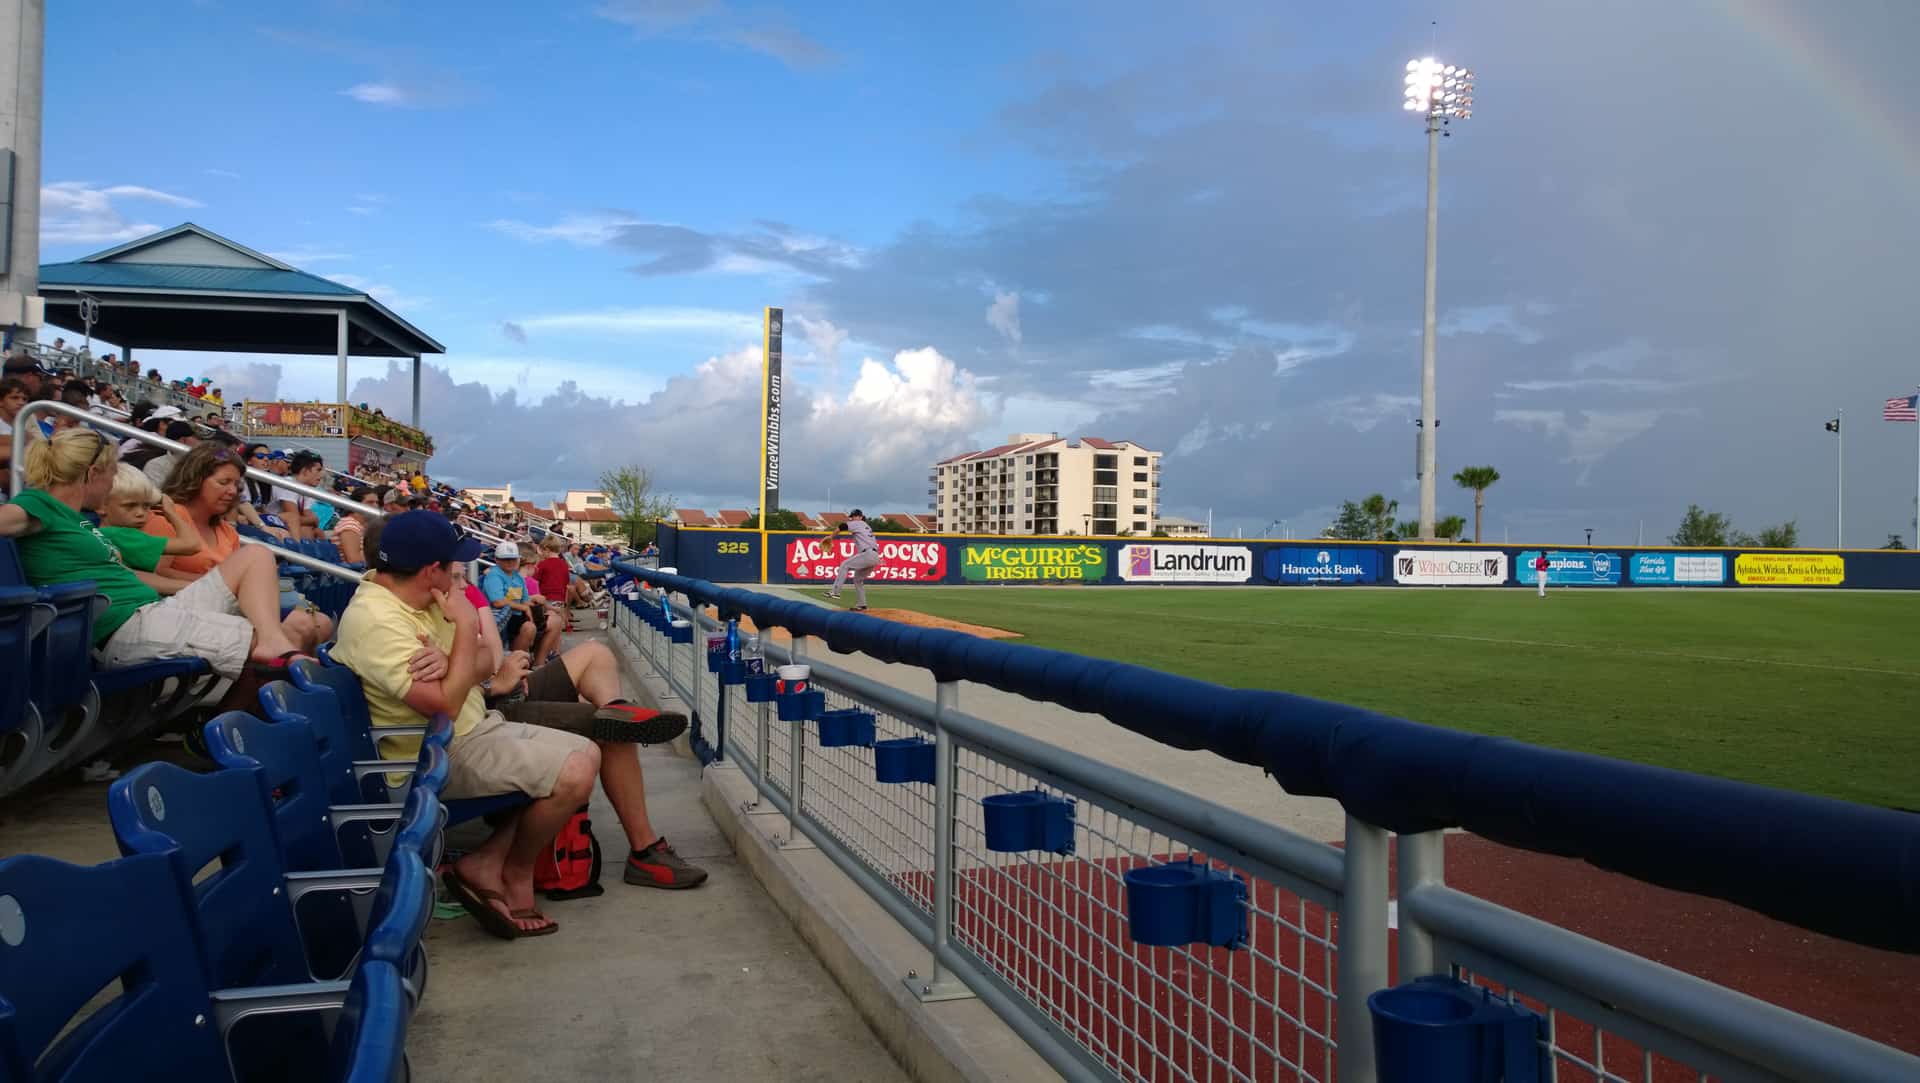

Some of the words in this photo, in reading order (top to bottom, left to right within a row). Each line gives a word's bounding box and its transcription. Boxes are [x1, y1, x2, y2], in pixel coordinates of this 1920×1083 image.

[766, 375, 780, 490] VinceWhibbs.com
[717, 541, 749, 554] 325
[840, 543, 939, 566] UOCKS
[1154, 548, 1246, 571] Landrum
[985, 566, 1038, 579] IRISH
[1043, 566, 1083, 579] PUB
[1282, 563, 1332, 574] Hancock
[1334, 564, 1363, 575] Bank
